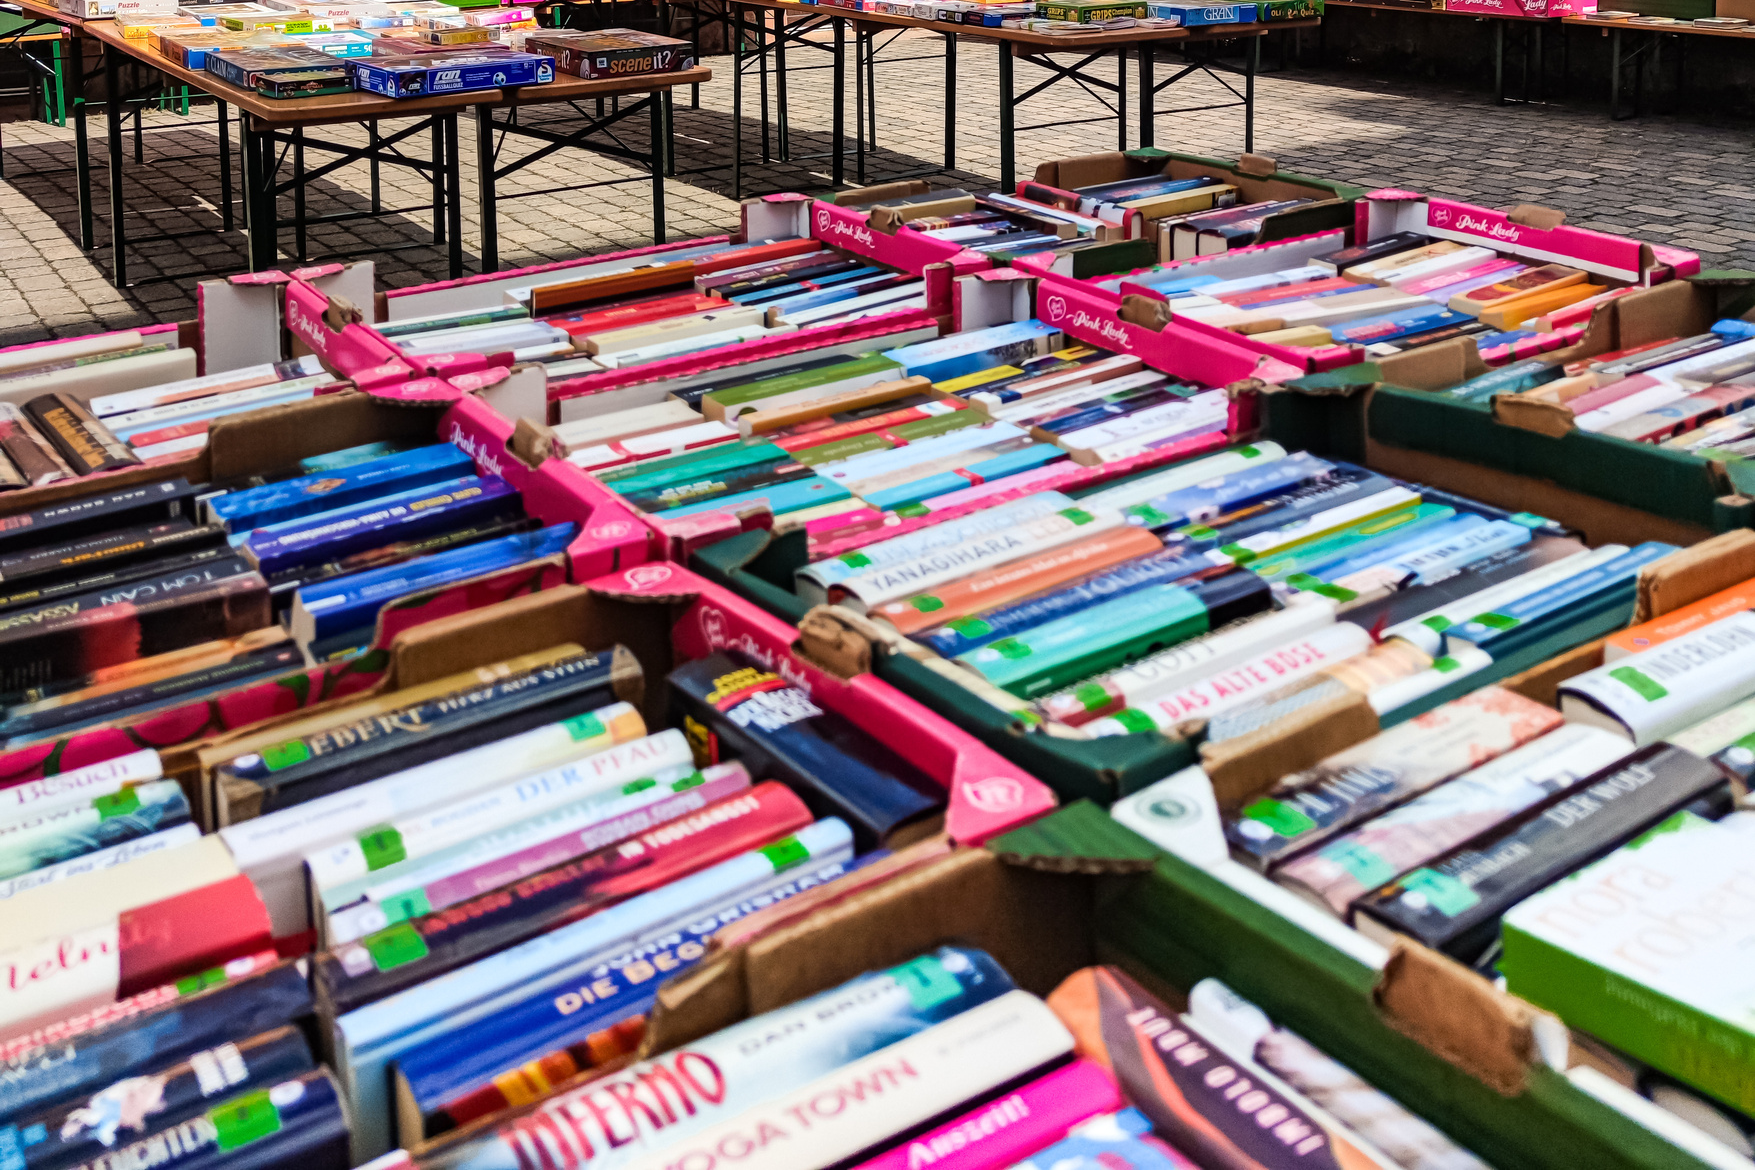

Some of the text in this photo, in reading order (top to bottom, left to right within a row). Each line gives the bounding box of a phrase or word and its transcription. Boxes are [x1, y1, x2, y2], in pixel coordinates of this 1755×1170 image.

[117, 1, 140, 9] Puzzle
[327, 9, 350, 17] Puzzle
[1091, 8, 1133, 22] GRIPS Champion
[435, 69, 461, 81] ran
[609, 50, 672, 74] scene it?
[433, 81, 464, 90] FUSSBALLQUIZ
[831, 219, 876, 249] Pink Lady
[1455, 214, 1521, 242] Pink Lady
[1067, 310, 1133, 349] Pink Lady
[868, 535, 1022, 594] YANAGIHARA
[100, 571, 213, 608] TOM CAIN
[1158, 688, 1211, 721] DAS
[1212, 659, 1270, 700] ALTE
[310, 704, 429, 758] EBERT
[513, 765, 584, 804] DER
[589, 734, 670, 779] PFAU
[1596, 764, 1657, 806] WOLF
[555, 935, 706, 1016] DIE BEG
[786, 1059, 920, 1133] TOWN
